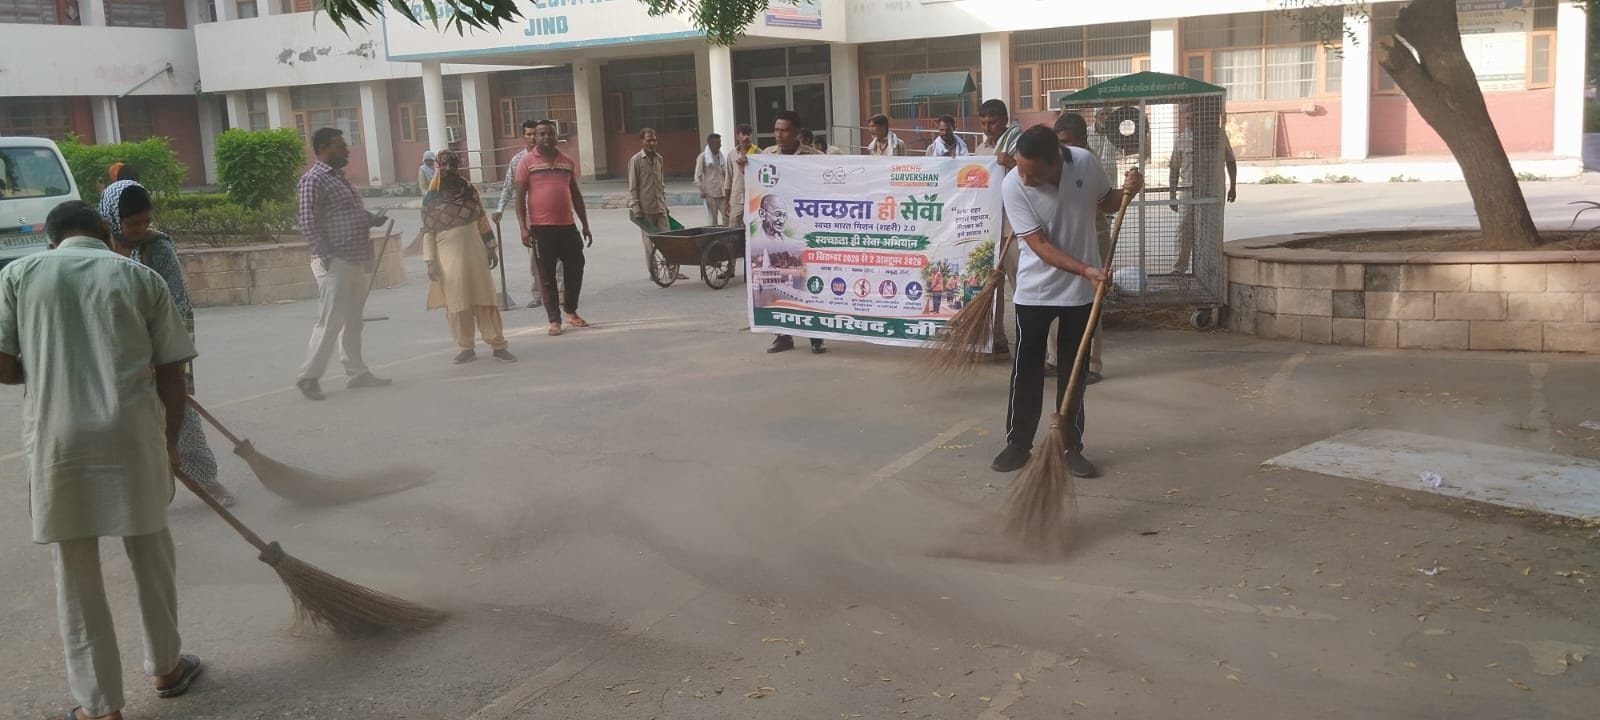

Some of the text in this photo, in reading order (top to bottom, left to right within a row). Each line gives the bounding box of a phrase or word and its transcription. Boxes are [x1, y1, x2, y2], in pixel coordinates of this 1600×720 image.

[524, 15, 569, 36] JIND
[890, 173, 939, 181] SURVEKSHAN
[793, 195, 944, 221] स्वच्छता ही सेवा
[834, 222, 851, 230] भारत
[876, 222, 901, 233] (शहरी)
[816, 234, 918, 248] स्वच्छता ही सेवा अभियान
[771, 311, 814, 327] नगर
[818, 314, 894, 336] परिषद,
